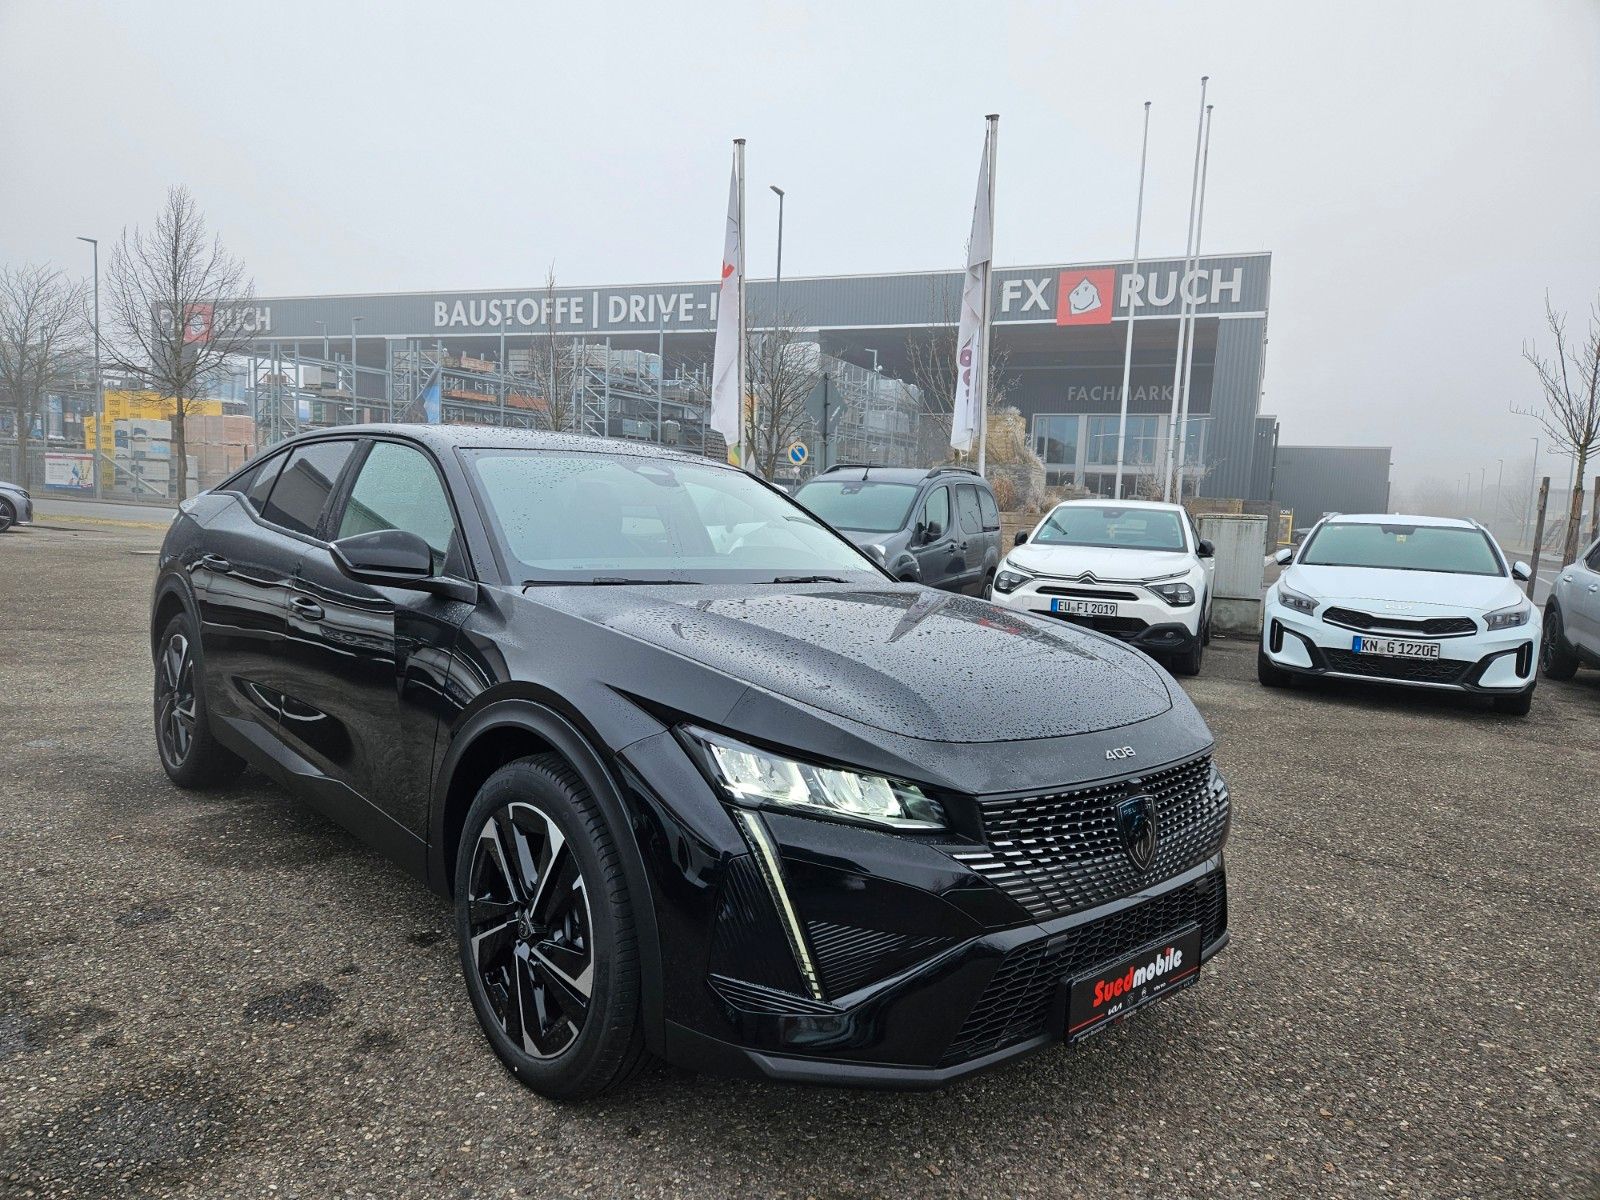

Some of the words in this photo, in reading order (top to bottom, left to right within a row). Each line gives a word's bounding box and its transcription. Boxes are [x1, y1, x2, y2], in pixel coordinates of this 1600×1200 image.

[1001, 277, 1051, 312] FX
[1120, 267, 1243, 308] RUCH
[434, 296, 584, 327] BAUSTOFFE
[1058, 600, 1071, 612] EU
[1077, 602, 1088, 613] FI
[1091, 603, 1116, 615] 2019
[1361, 639, 1378, 652] KN
[1386, 641, 1395, 653] G
[1398, 642, 1438, 657] 1220E
[1105, 746, 1136, 760] 408
[1092, 946, 1183, 1008] Suedmobile
